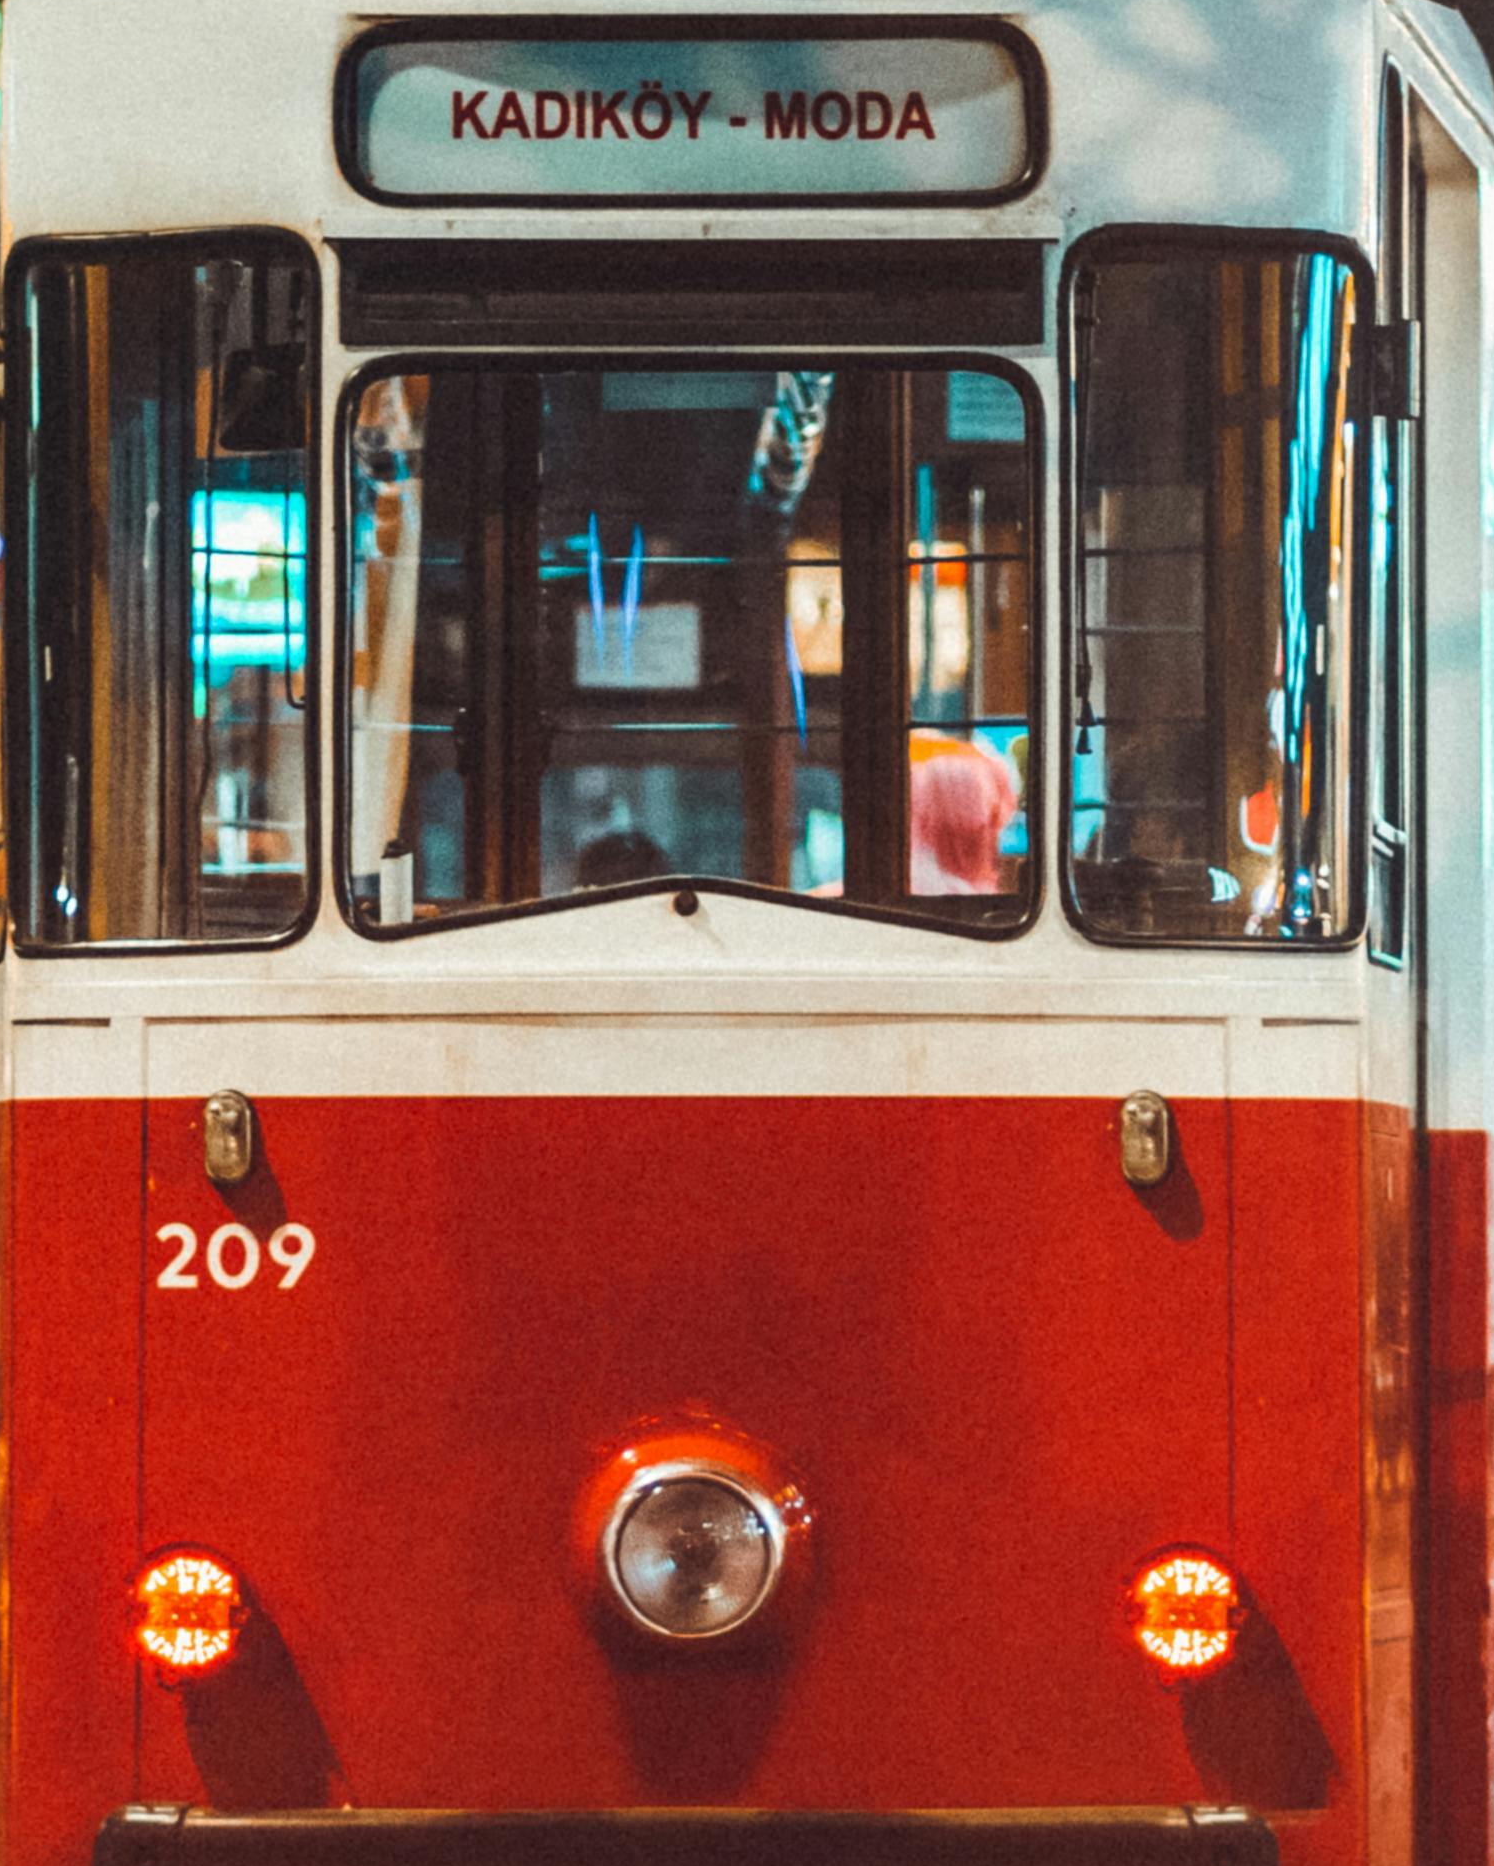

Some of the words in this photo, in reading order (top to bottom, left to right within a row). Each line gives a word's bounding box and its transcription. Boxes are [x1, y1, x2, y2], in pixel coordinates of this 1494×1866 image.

[451, 81, 714, 141] KADIKÖY
[727, 113, 749, 129] -
[764, 90, 936, 141] MODA
[155, 1222, 317, 1290] 209
